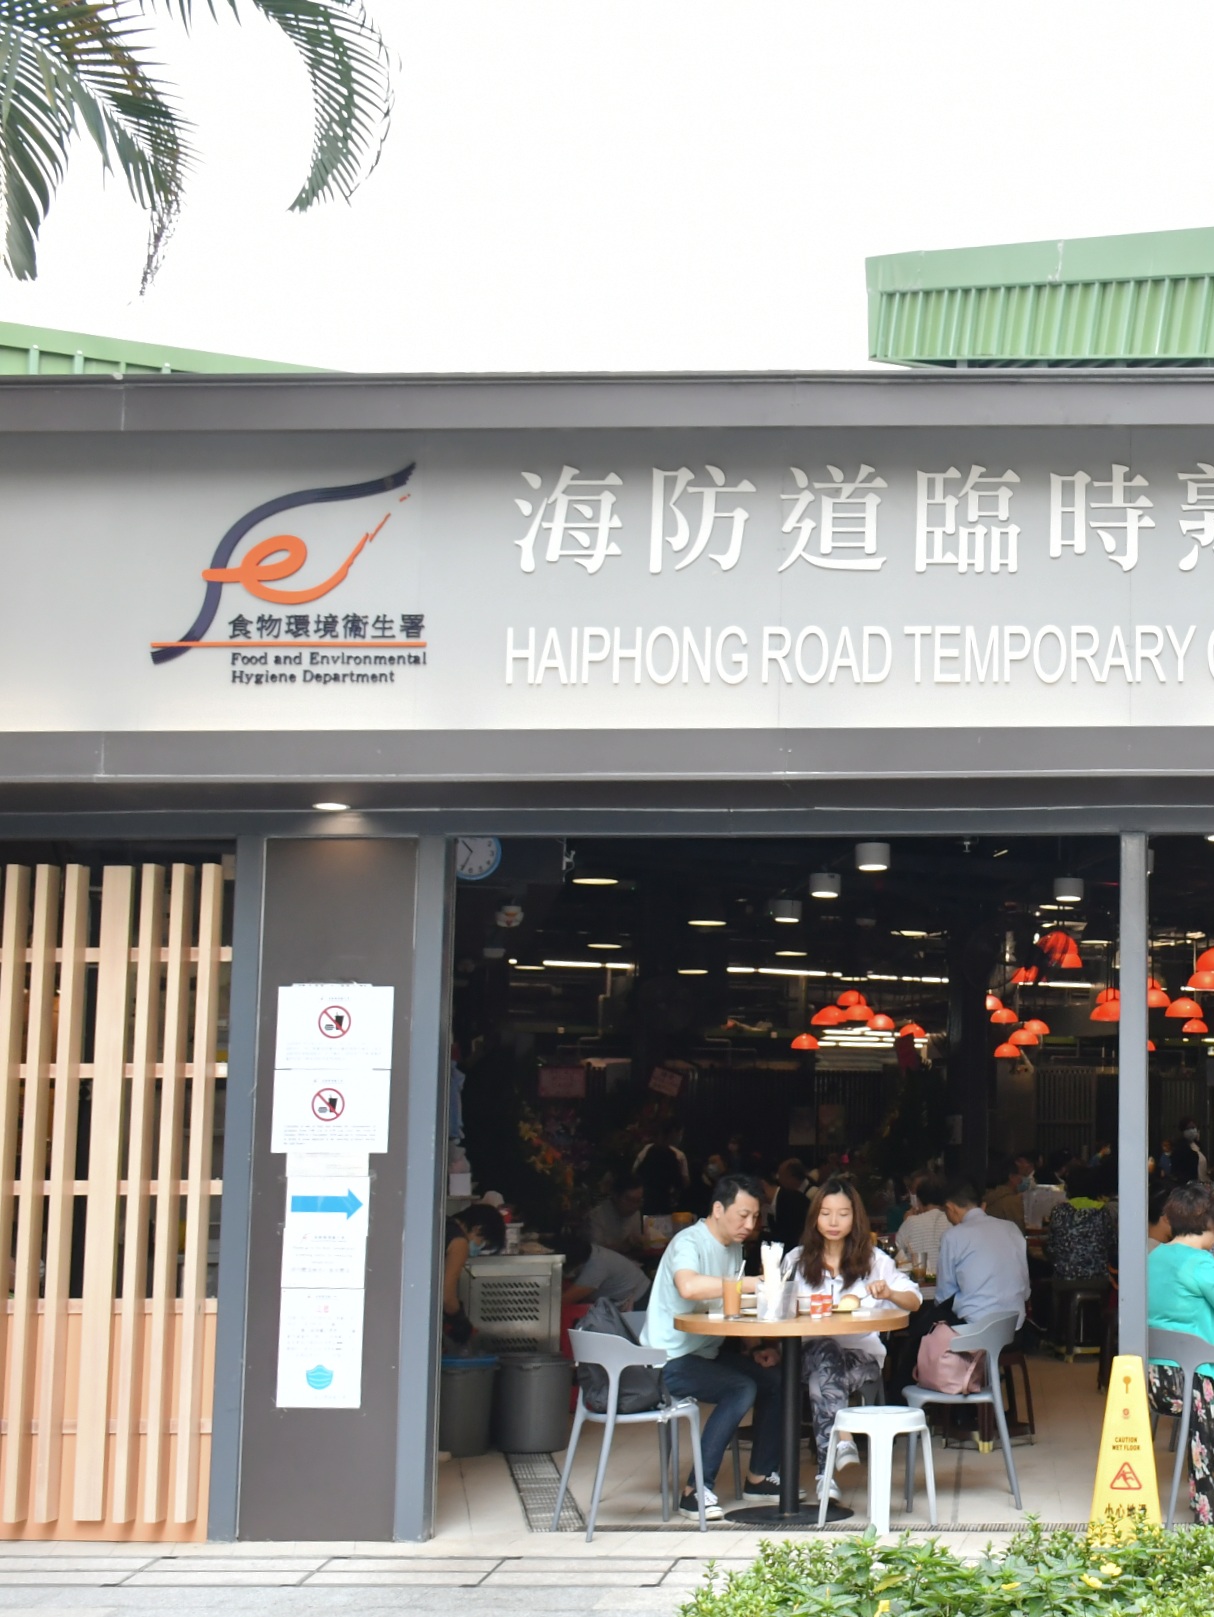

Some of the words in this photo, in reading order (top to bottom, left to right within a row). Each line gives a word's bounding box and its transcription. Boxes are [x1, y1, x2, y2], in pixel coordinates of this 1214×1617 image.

[231, 652, 268, 666] Food
[273, 652, 302, 666] and
[309, 652, 427, 666] Environmental
[504, 625, 748, 685] HAIPHONG
[761, 625, 893, 685] ROAD
[904, 624, 1196, 684] TEMPORARY
[231, 670, 297, 685] Hygiene
[303, 669, 395, 685] Department
